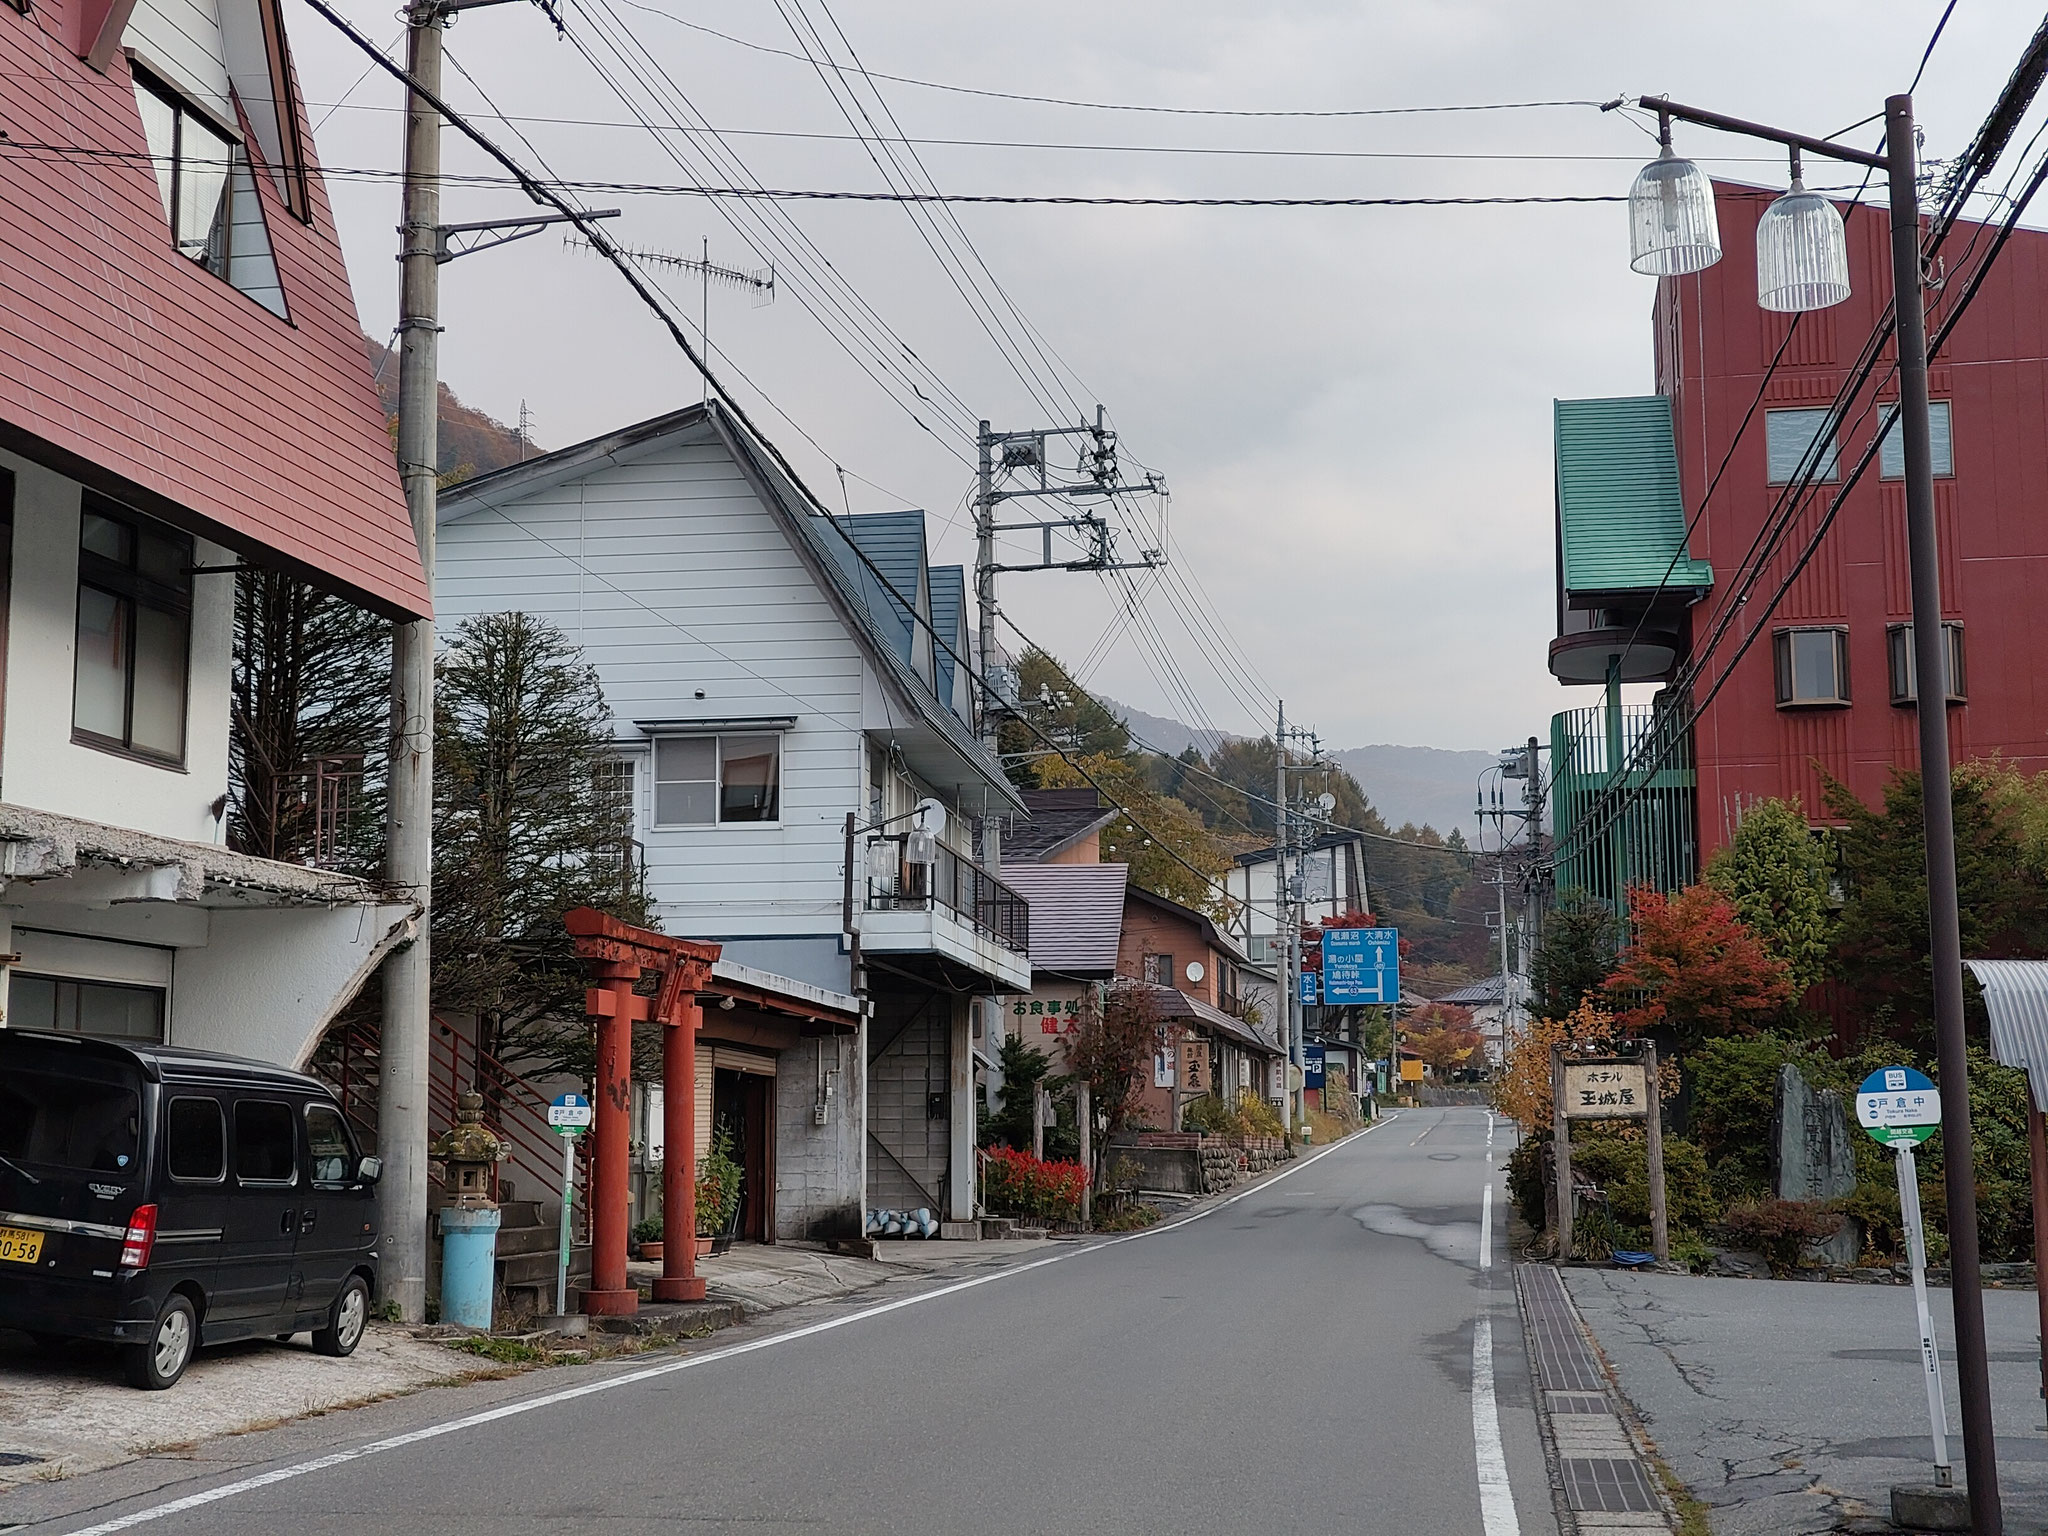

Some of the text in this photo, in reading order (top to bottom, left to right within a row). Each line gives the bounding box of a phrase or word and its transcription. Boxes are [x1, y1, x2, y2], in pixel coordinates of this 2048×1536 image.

[1330, 930, 1394, 941] 尾瀬沼 大清水
[1328, 954, 1364, 964] 湯の小屋
[1332, 970, 1360, 980] 鳩待峠
[1303, 975, 1313, 993] 水上
[1013, 1000, 1080, 1015] お食事処
[1587, 1072, 1623, 1083] ホテル
[1579, 1088, 1636, 1106] 玉城屋
[1877, 1096, 1925, 1109] 戸倉中
[88, 1183, 126, 1194] EVERY
